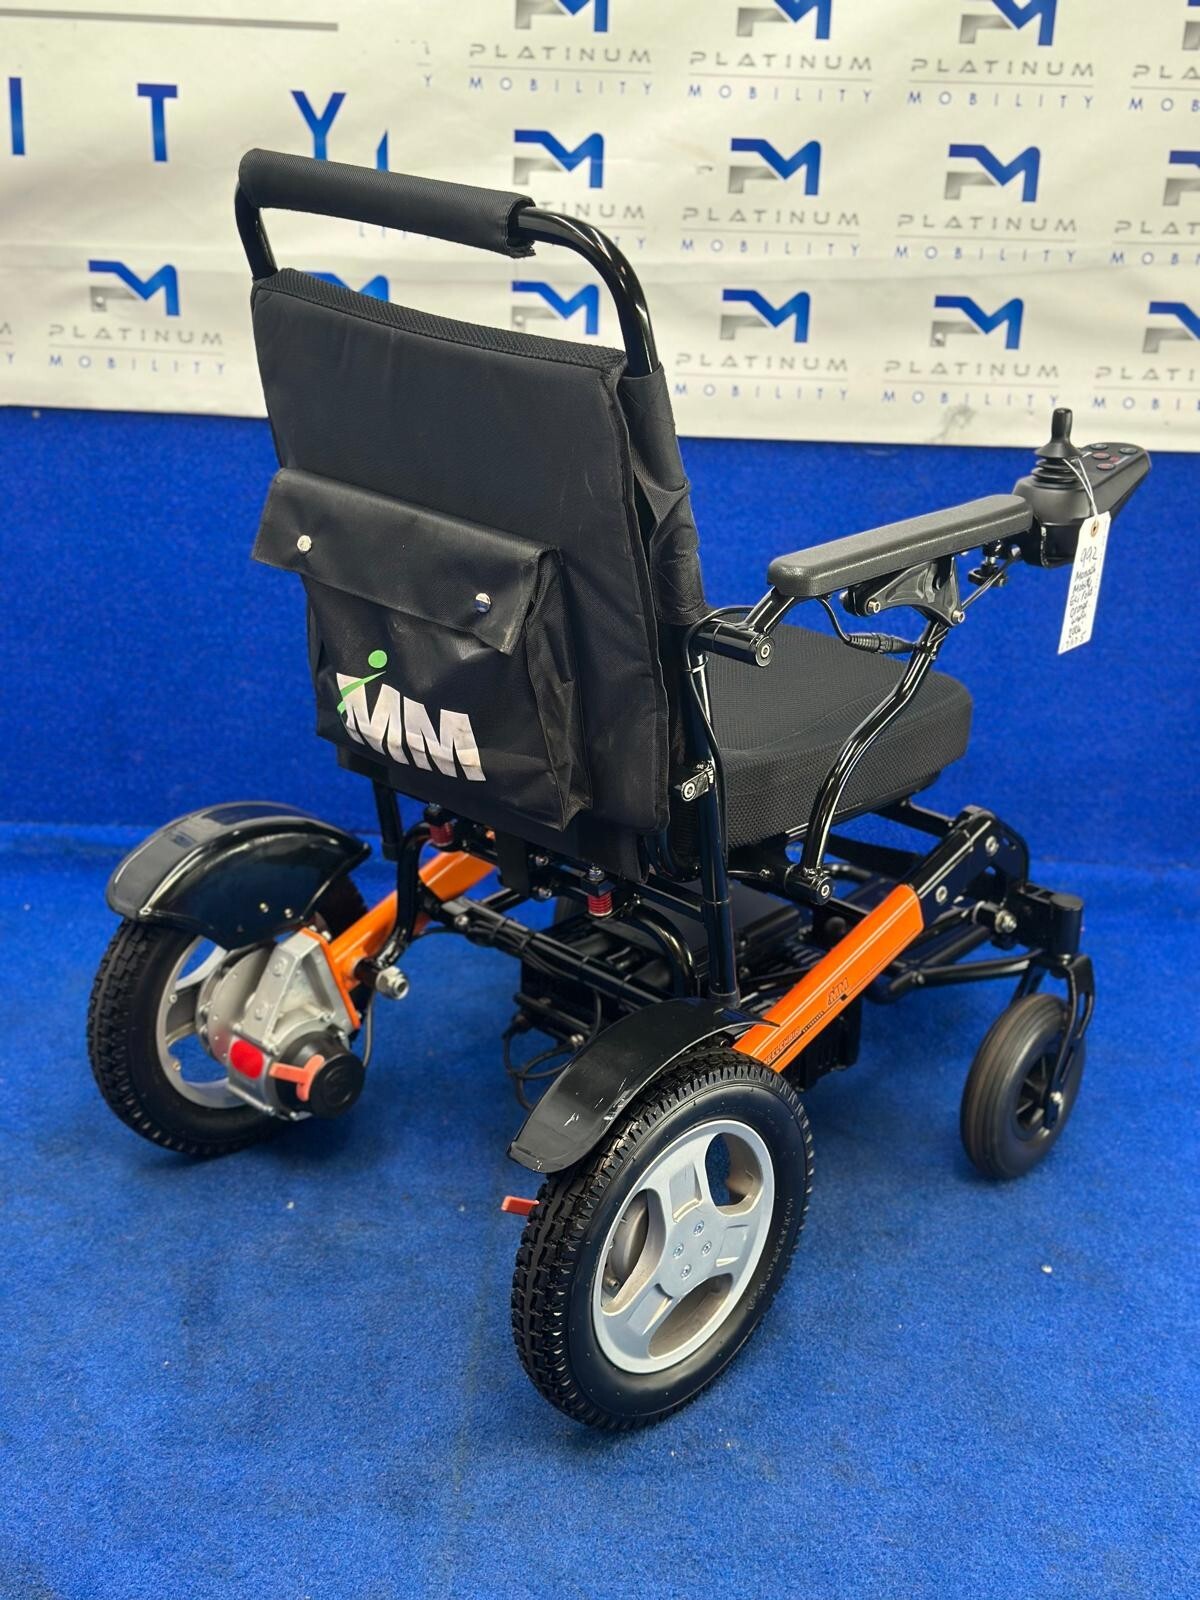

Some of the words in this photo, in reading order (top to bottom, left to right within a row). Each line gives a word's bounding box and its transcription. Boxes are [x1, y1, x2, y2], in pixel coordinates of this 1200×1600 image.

[469, 44, 651, 64] PLATINUM
[689, 51, 873, 71] PLATINUM
[910, 58, 1094, 78] PLATINUM
[468, 77, 653, 95] MOBILITY
[688, 85, 873, 103] MOBILITY
[907, 91, 1095, 110] MOBILITY
[682, 207, 860, 227] PLATINUM
[897, 214, 1077, 233] PLATINUM
[680, 239, 860, 257] MOBILITY
[895, 246, 1077, 263] MOBILITY
[49, 324, 223, 346] PLATINUM
[49, 354, 225, 375] MOBILITY
[675, 353, 848, 372] PLATINUM
[884, 360, 1060, 378] PLATINUM
[675, 383, 848, 400] MOBILITY
[882, 391, 1059, 407] MOBILITY
